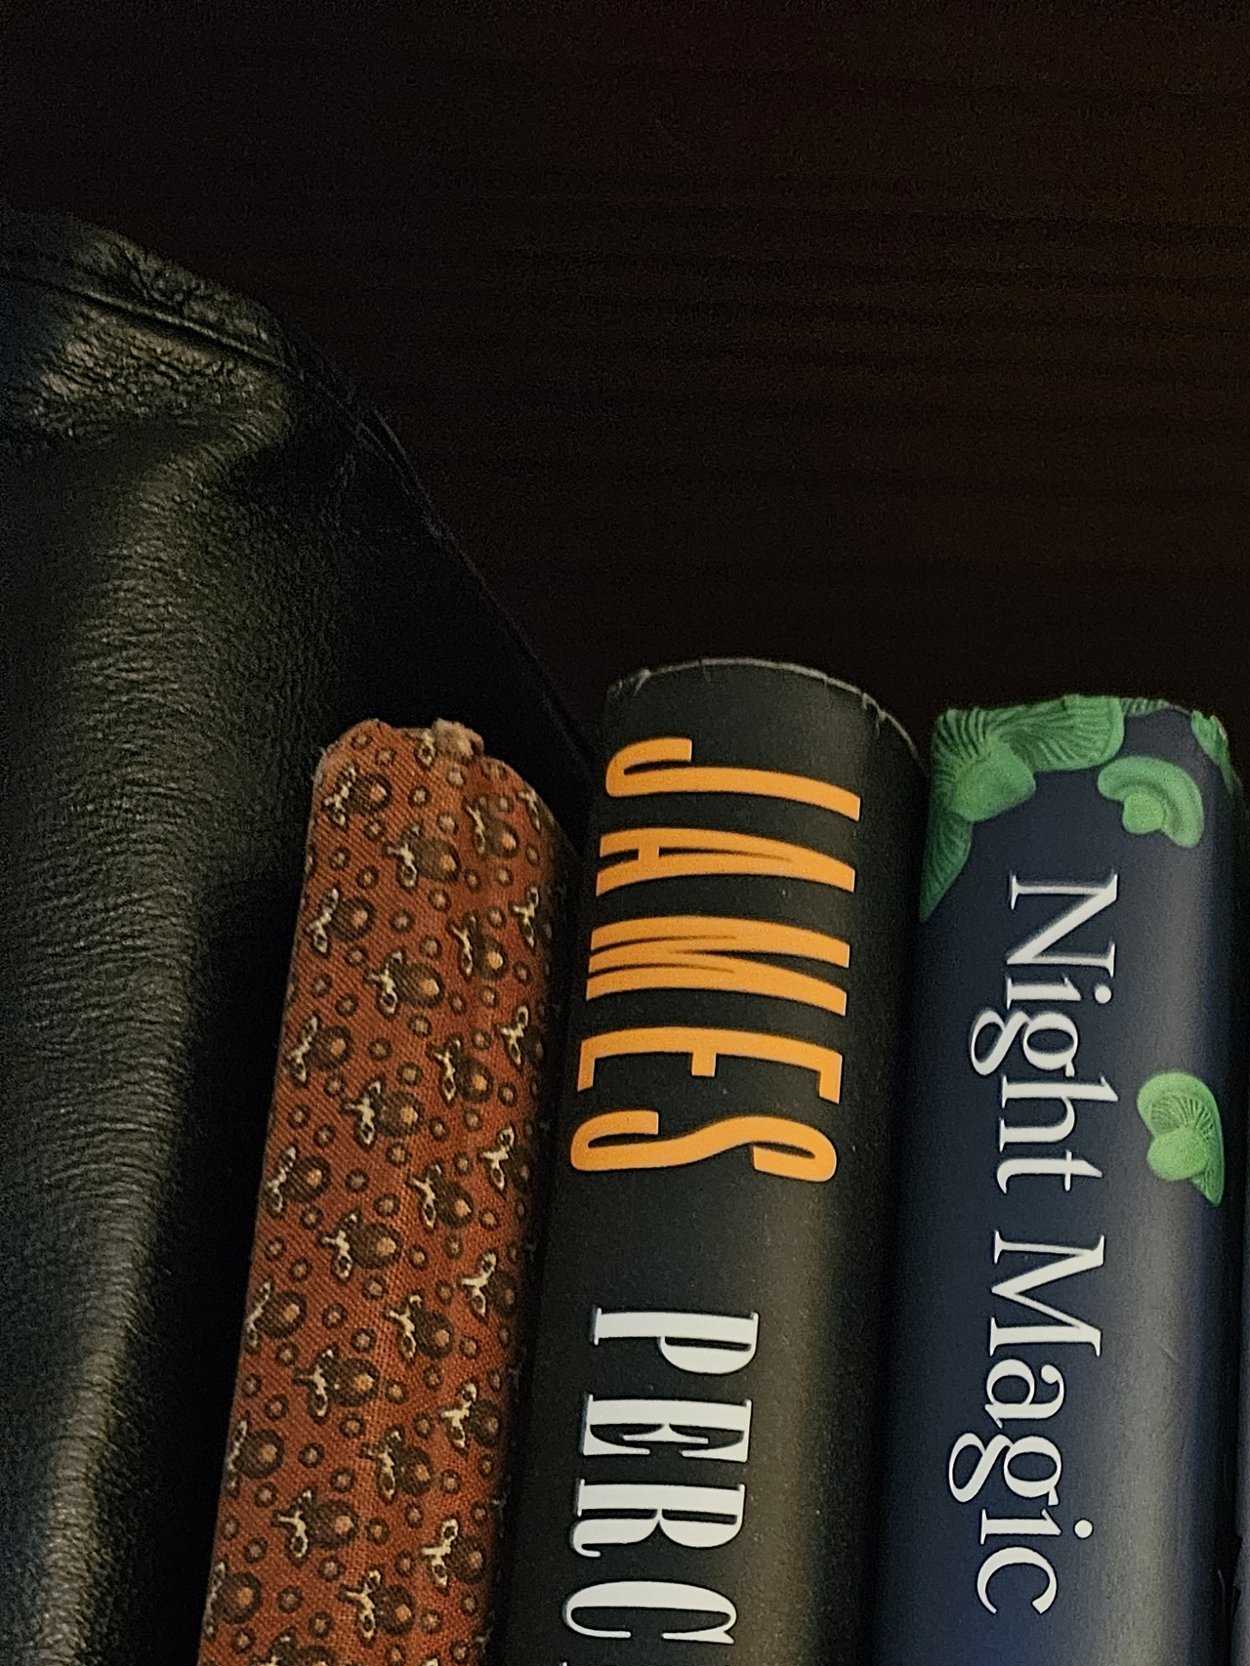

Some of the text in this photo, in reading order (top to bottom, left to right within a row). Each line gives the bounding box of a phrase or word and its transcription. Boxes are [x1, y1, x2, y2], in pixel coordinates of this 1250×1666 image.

[570, 737, 861, 1182] JAMES
[948, 873, 1119, 1614] Night Magic
